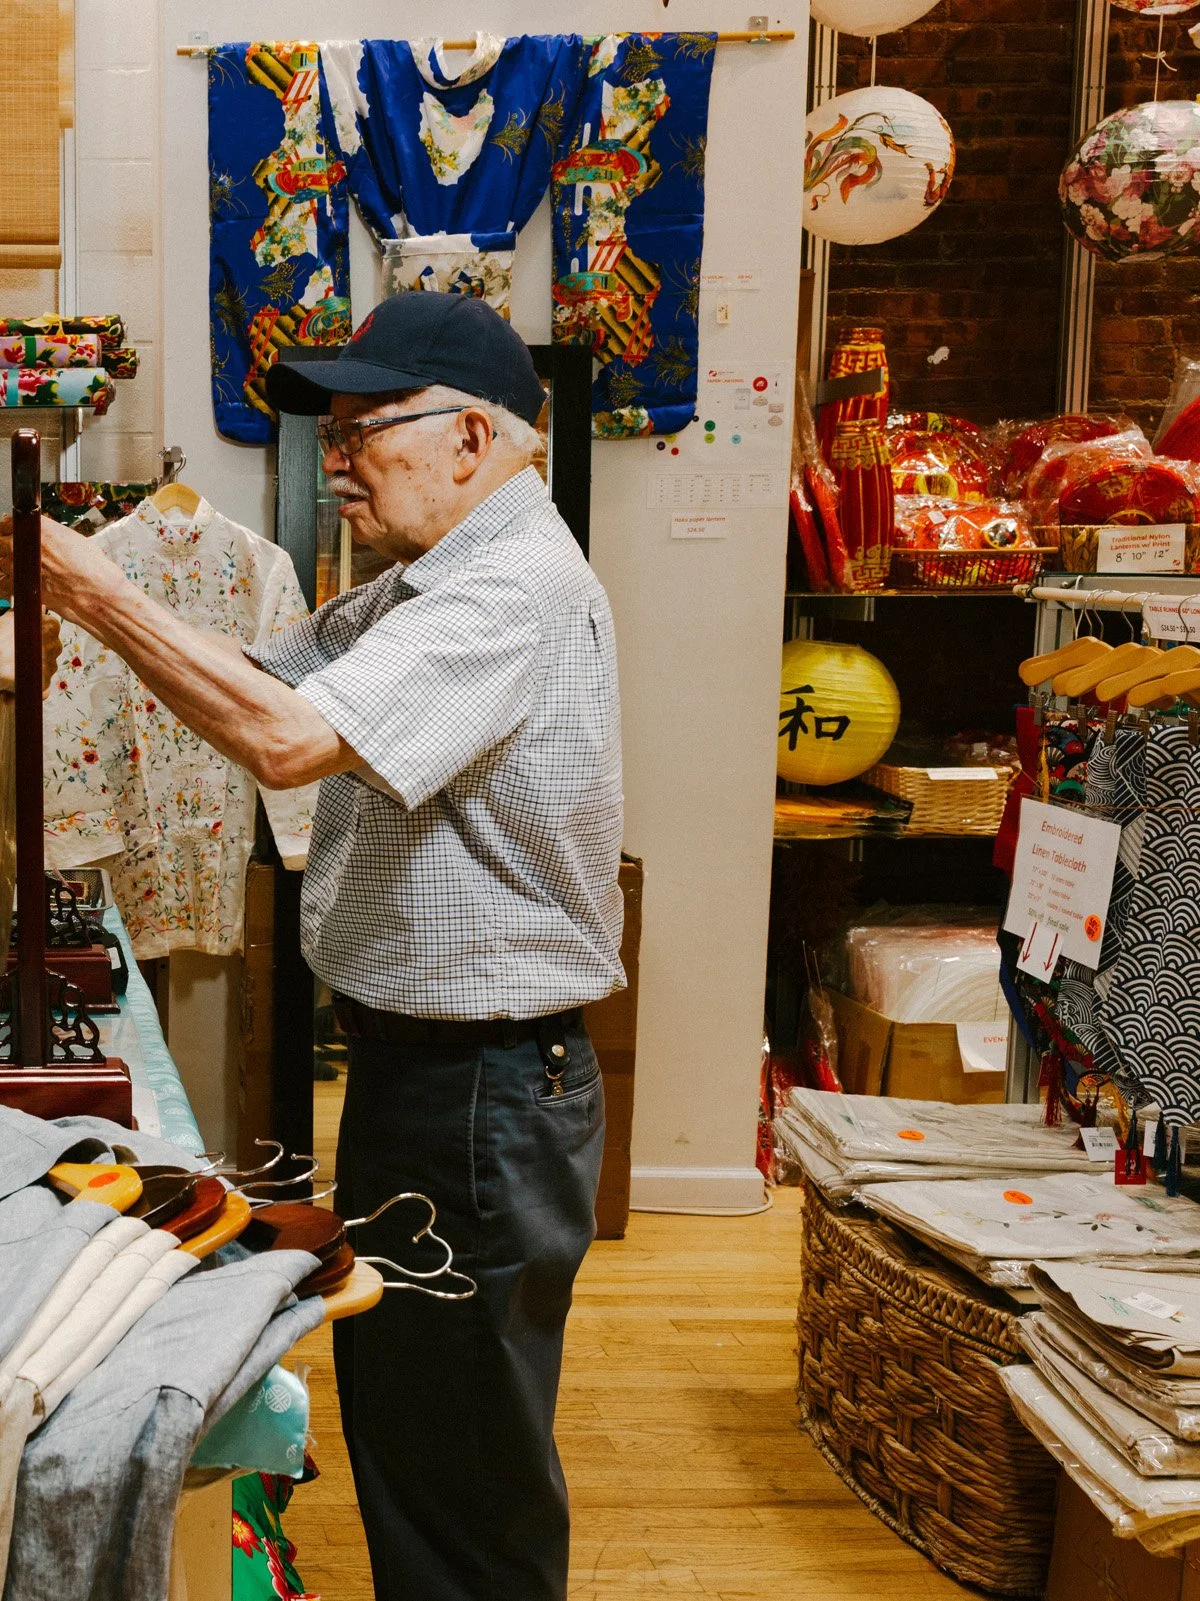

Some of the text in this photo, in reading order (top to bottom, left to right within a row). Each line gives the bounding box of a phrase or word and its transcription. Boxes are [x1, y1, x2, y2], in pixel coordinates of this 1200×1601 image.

[1112, 534, 1147, 543] Traditional
[779, 684, 851, 752] 和
[1041, 821, 1084, 845] Embroidered
[1031, 843, 1087, 873] Linen Tablecloth
